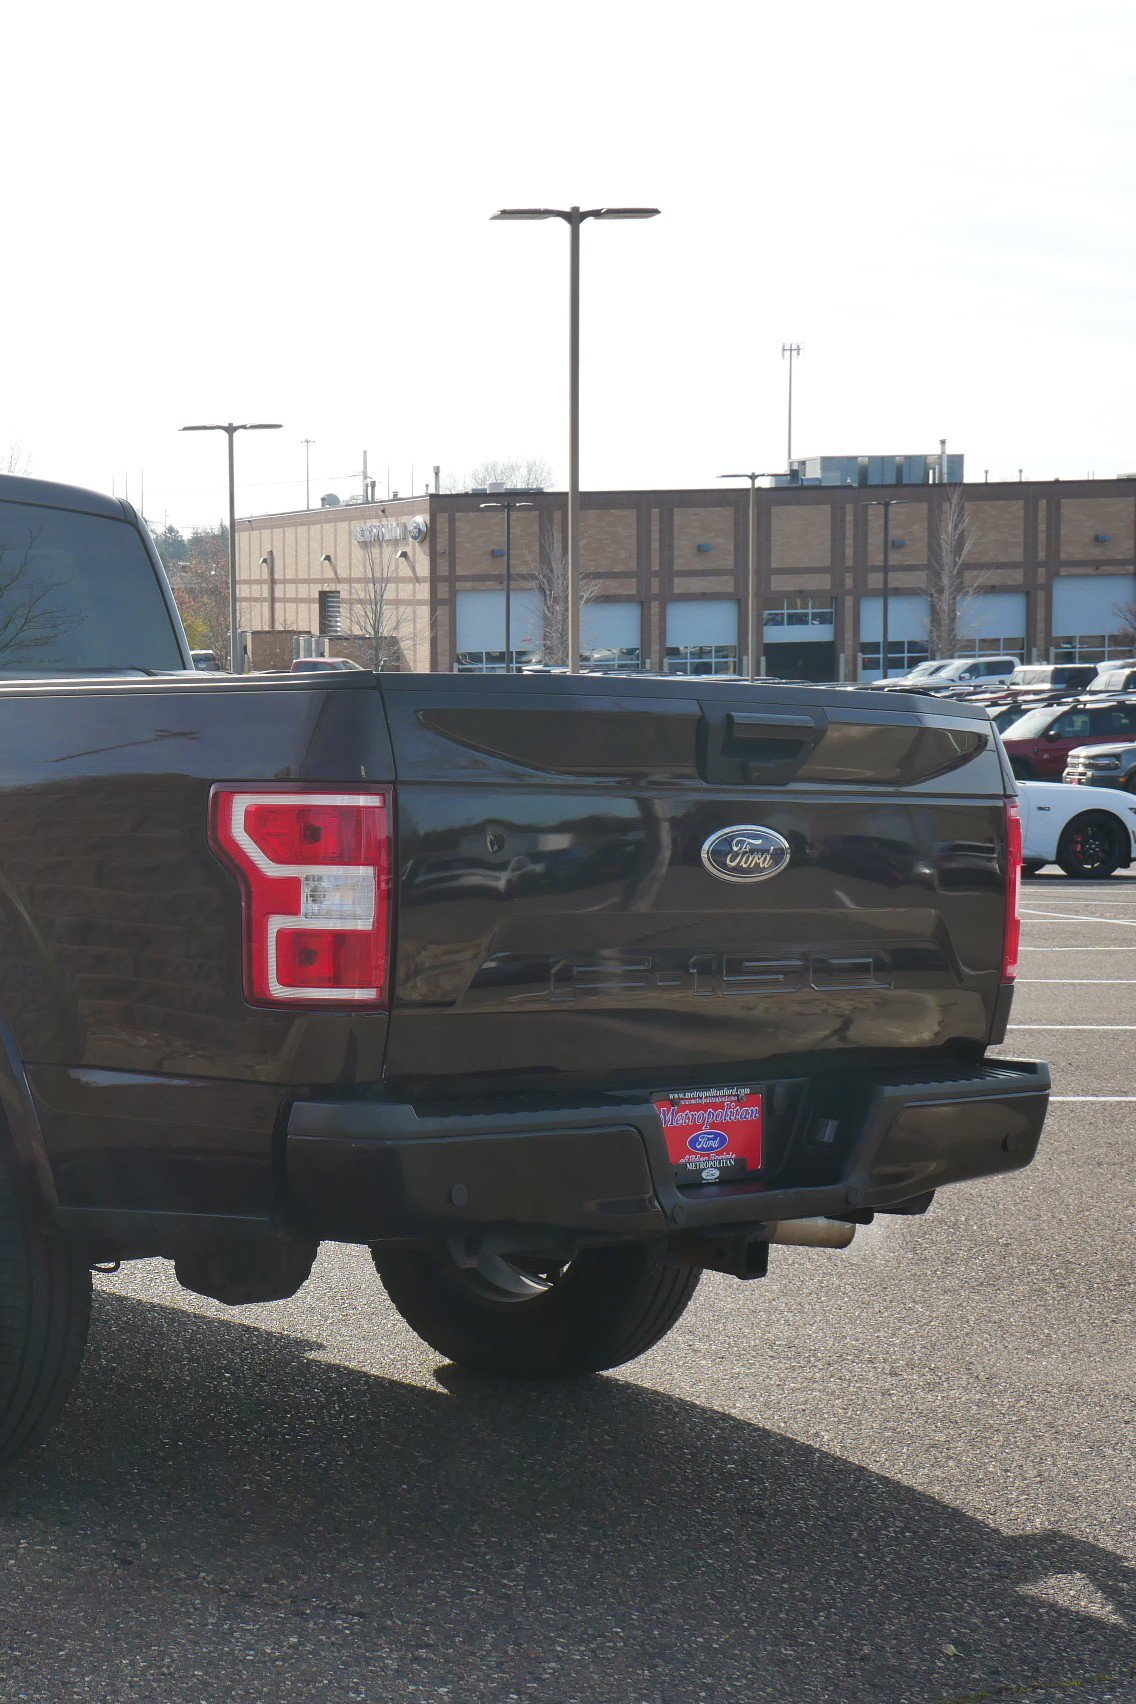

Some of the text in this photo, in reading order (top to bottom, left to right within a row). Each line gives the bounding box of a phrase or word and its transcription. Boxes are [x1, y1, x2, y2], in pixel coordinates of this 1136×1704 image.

[727, 837, 773, 868] Ford
[669, 1087, 750, 1099] www.metropolitanford.com
[660, 1102, 760, 1130] Metropolitan
[695, 1134, 720, 1149] Ford
[687, 1159, 735, 1170] METROPOLITAN
